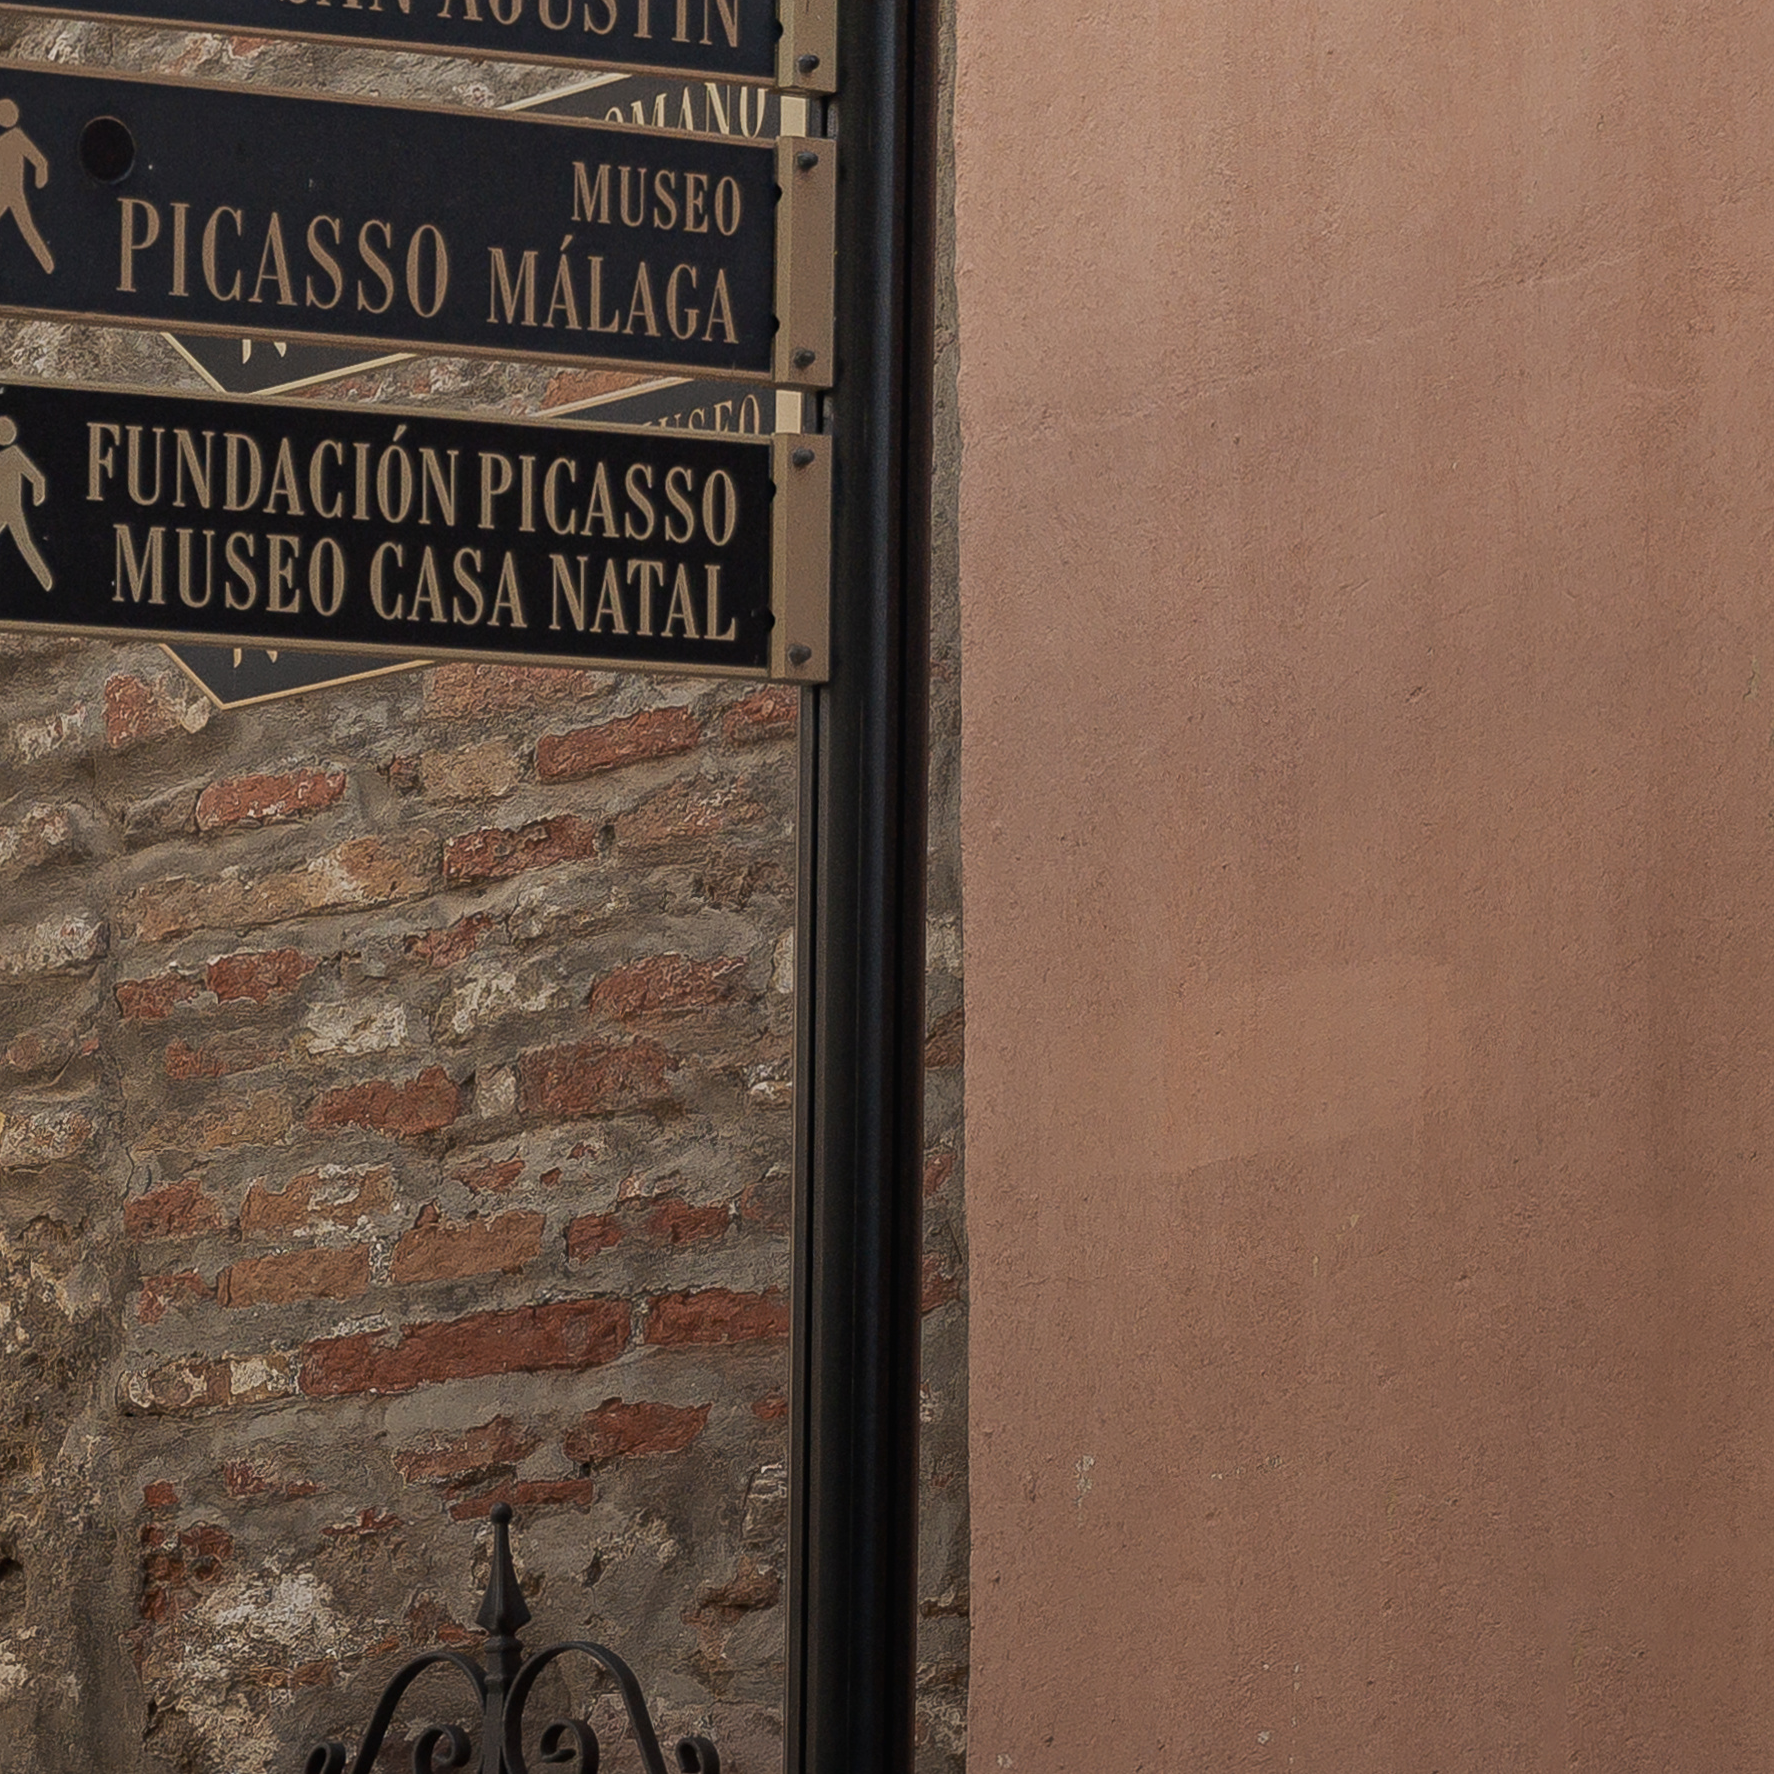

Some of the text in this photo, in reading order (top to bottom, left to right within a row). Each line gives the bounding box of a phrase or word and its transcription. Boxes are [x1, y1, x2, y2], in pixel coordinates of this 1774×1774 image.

[572, 161, 741, 236] MUSEO
[117, 198, 738, 343] PICASSO MÁLAGA
[86, 422, 737, 546] FUNDACIÓN PICASSO
[113, 524, 736, 641] MUSEO CASA NATAL
